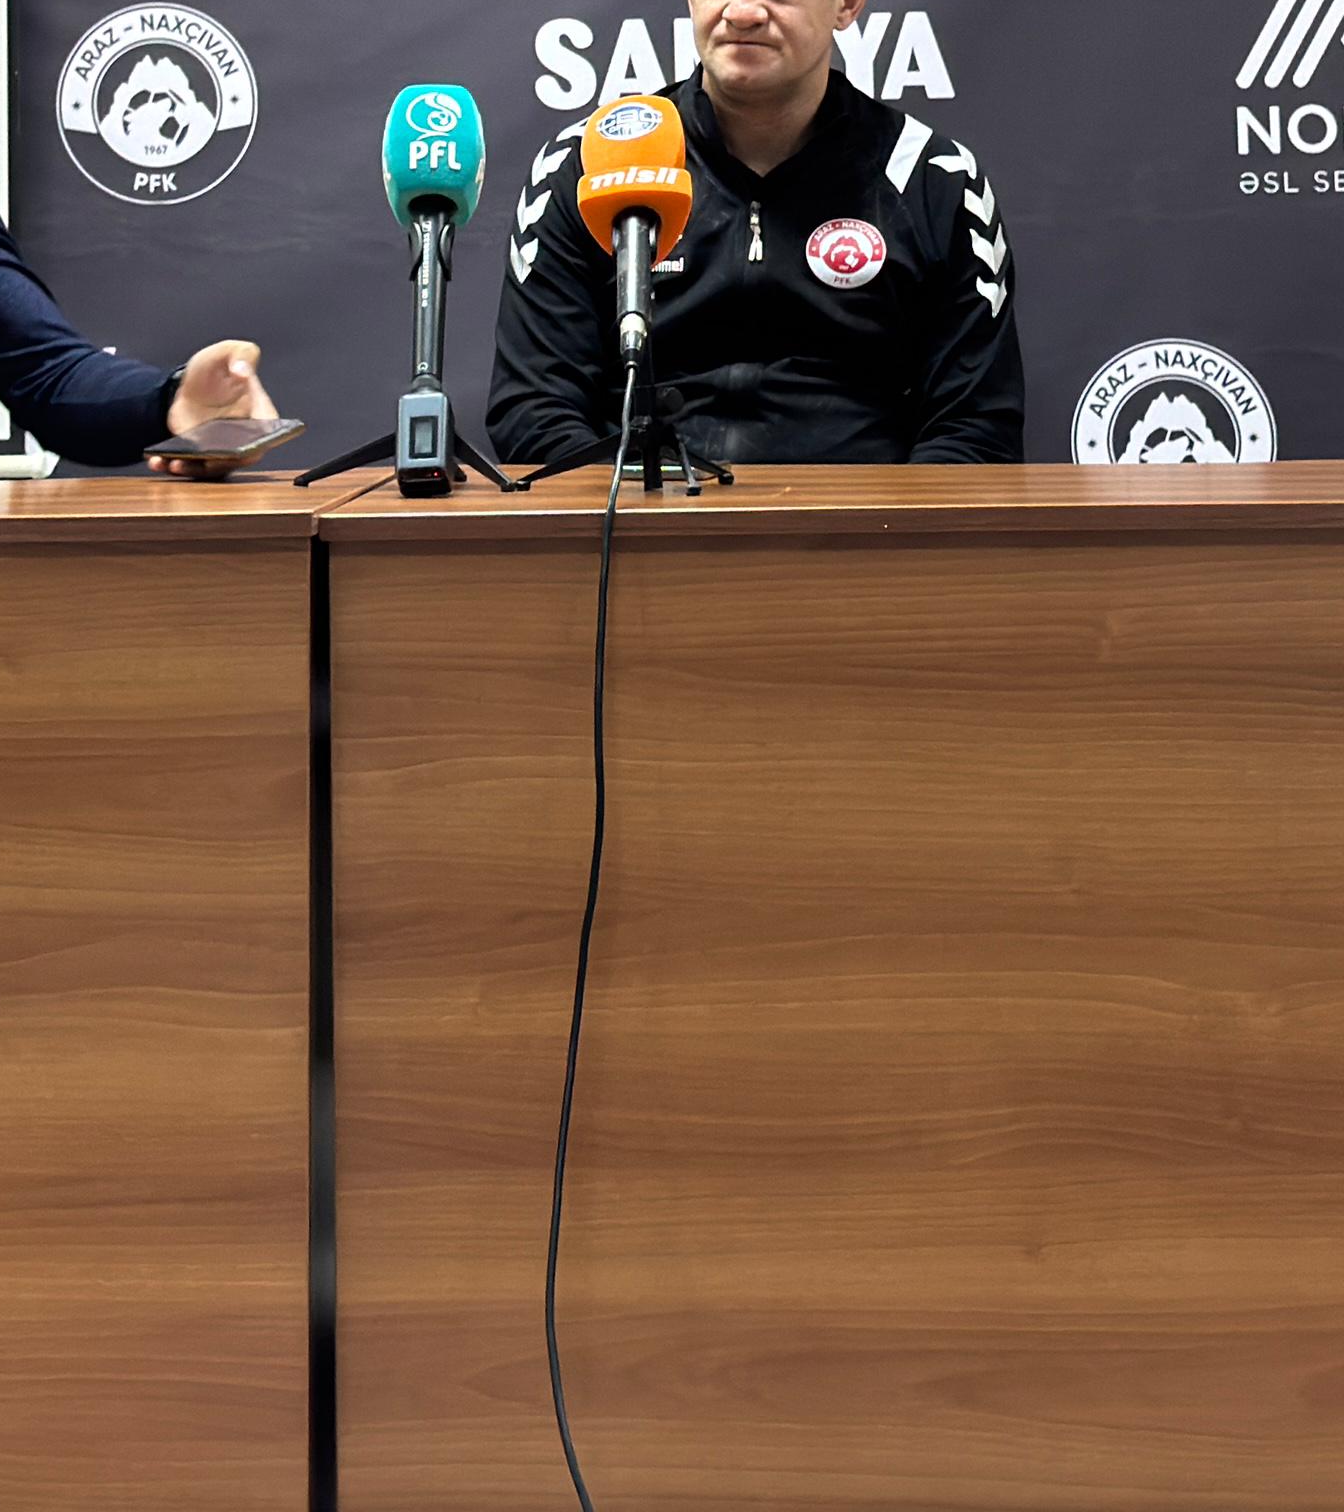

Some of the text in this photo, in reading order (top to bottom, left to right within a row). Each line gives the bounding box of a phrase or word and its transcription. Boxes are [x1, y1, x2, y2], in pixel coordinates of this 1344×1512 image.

[534, 10, 956, 111] SAYA
[408, 139, 462, 171] PFL
[133, 172, 177, 193] PFK
